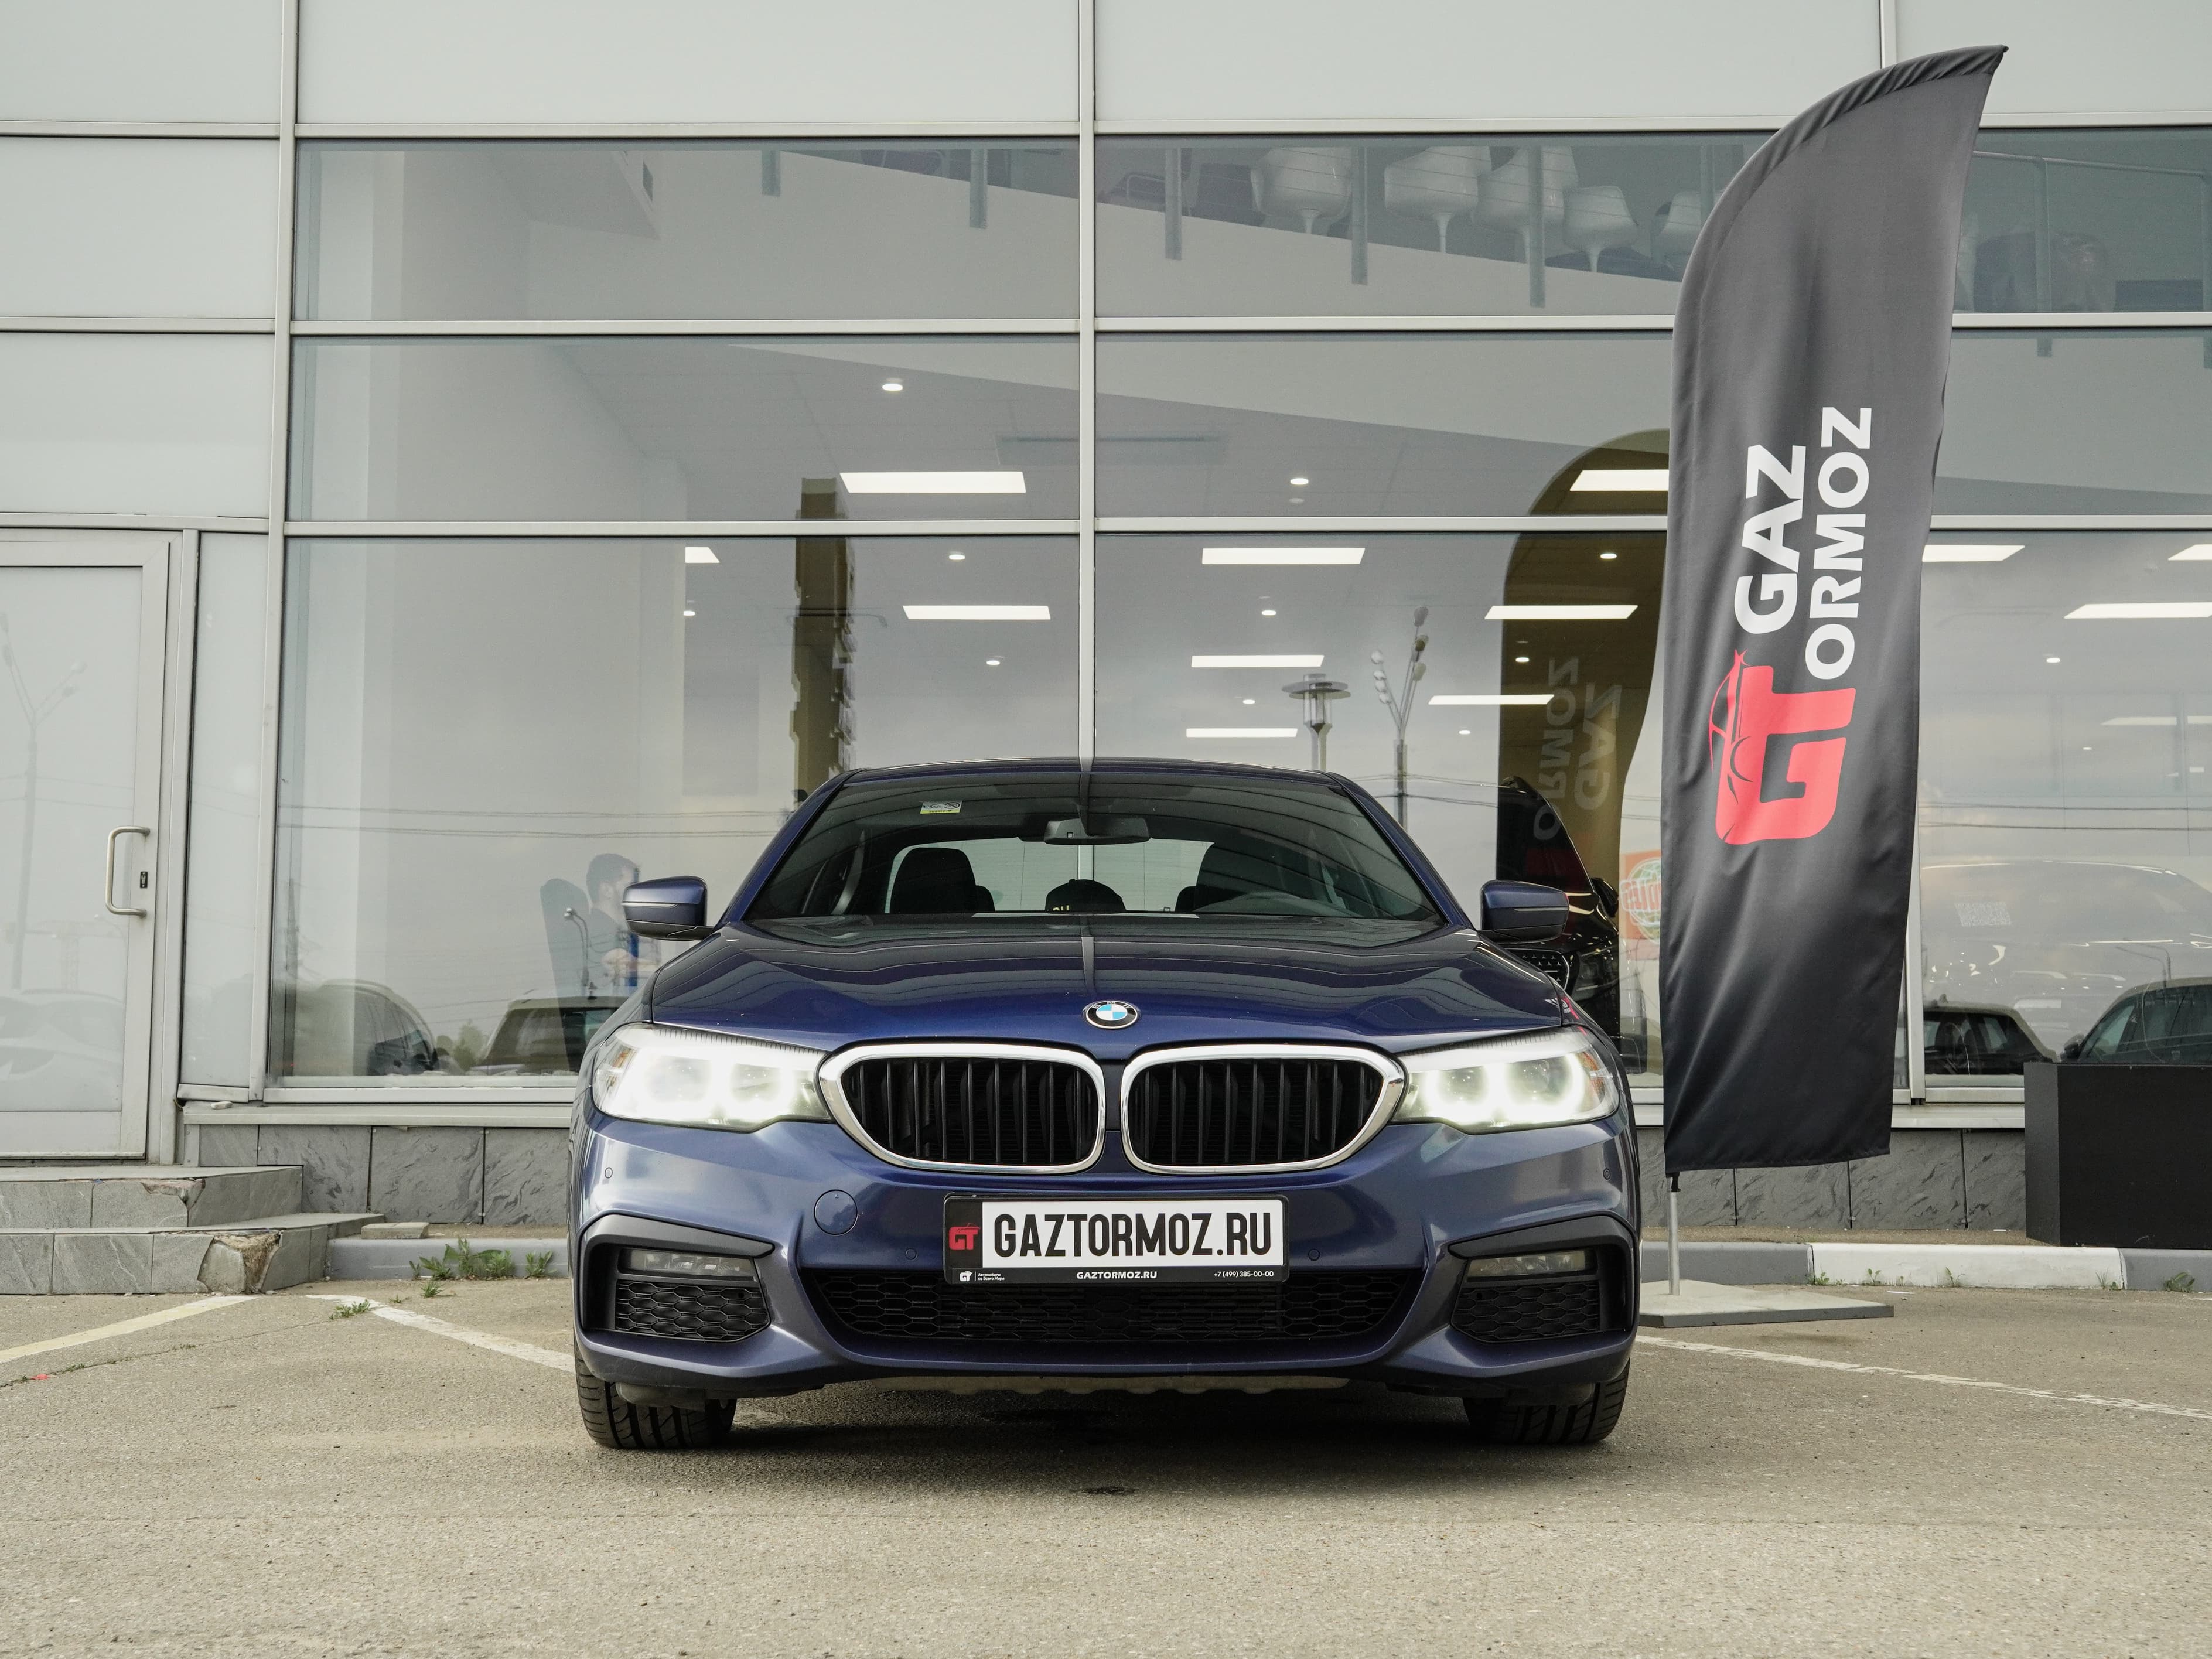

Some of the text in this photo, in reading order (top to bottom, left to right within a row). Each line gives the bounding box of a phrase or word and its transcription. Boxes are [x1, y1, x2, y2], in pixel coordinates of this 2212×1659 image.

[1735, 444, 1806, 634] GAZ
[949, 1224, 979, 1250] GT
[994, 1212, 1271, 1258] GAZTORMOZ.RU
[1076, 1271, 1158, 1279] GAZTORMOZ.RU
